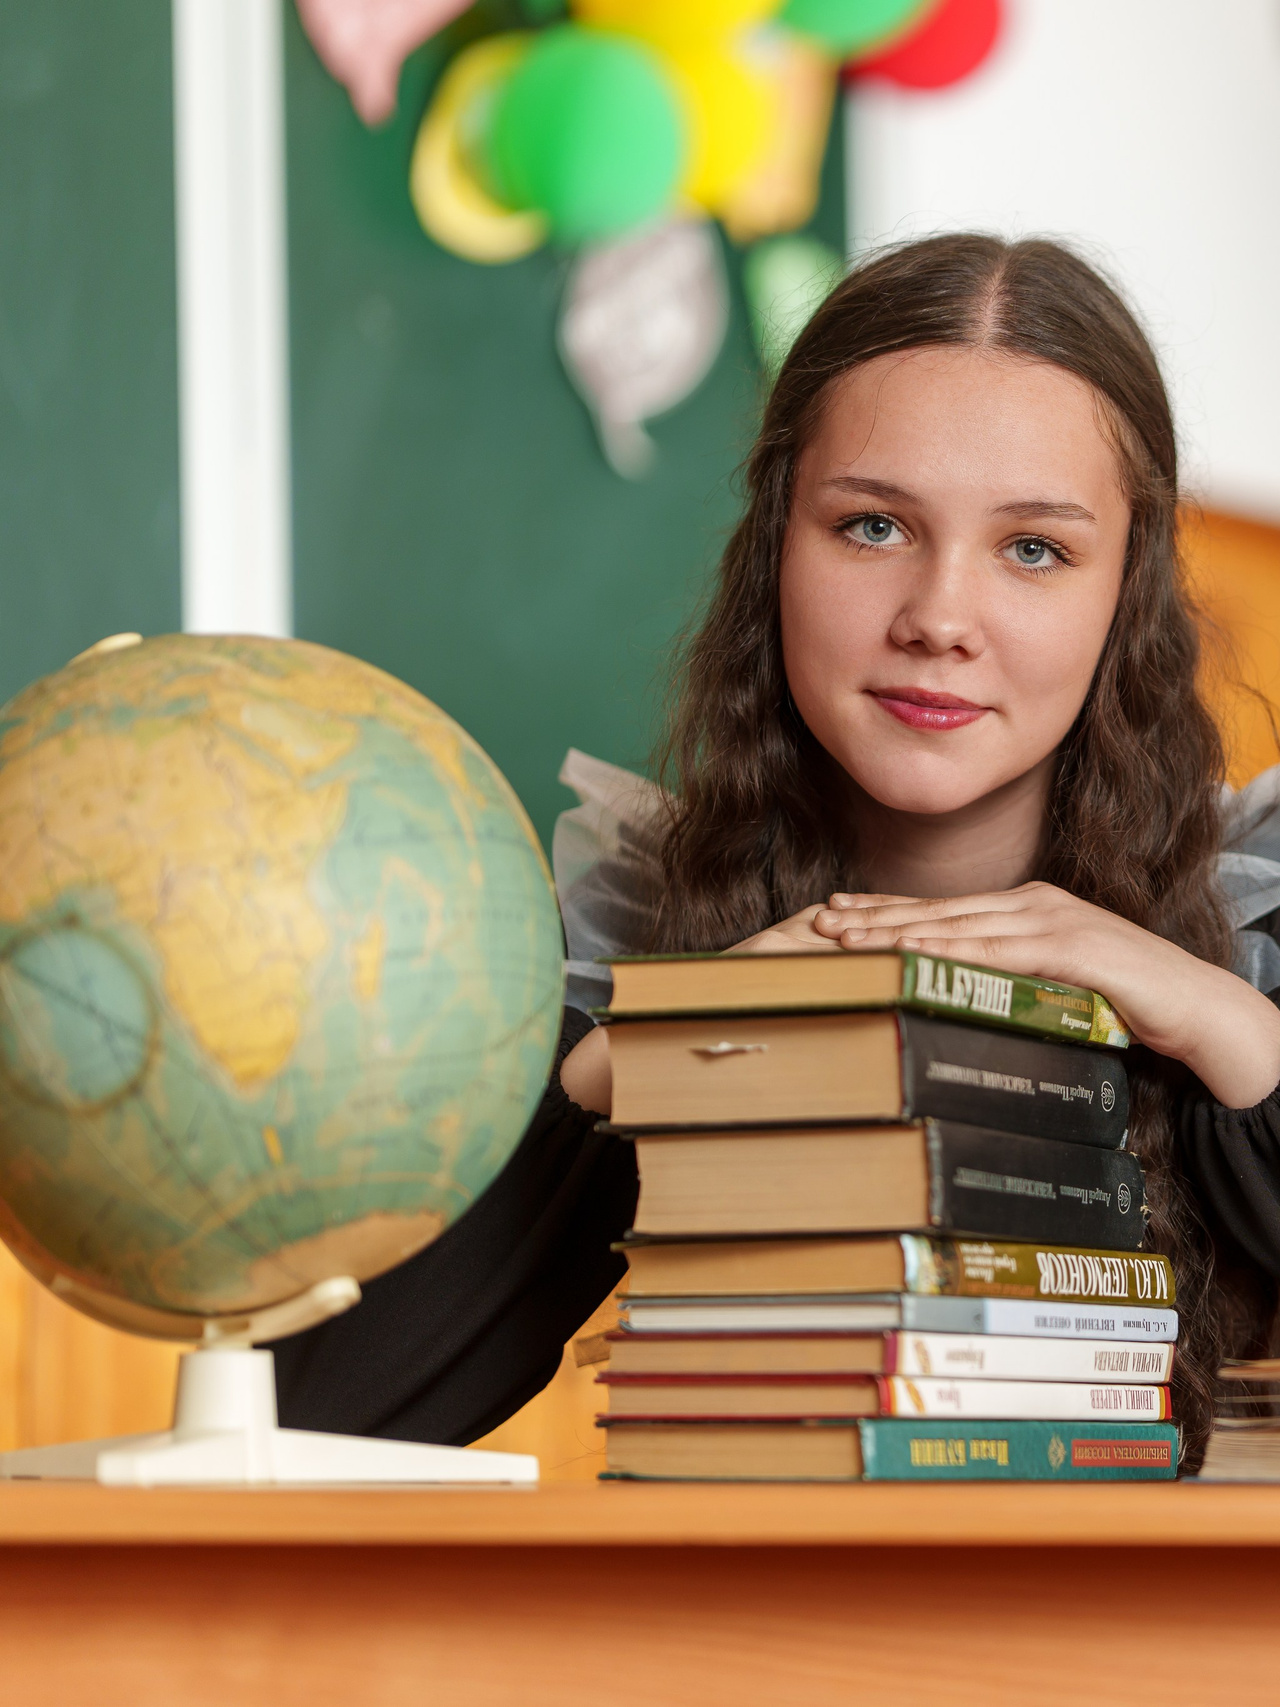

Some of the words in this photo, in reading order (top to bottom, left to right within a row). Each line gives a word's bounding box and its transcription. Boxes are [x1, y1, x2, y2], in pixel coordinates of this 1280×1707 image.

[1035, 1252, 1129, 1298] ЛЕРМОНТОВ
[1075, 1316, 1116, 1332] ЕВГЕНИЙ
[1123, 1318, 1152, 1332] Пушкин
[1094, 1349, 1130, 1372] ЦВЕТАЕВА
[1132, 1351, 1164, 1374] МАРИНА
[1089, 1386, 1122, 1410] АНДРЕЕВ
[1124, 1386, 1155, 1411] ЛЕОНИД
[969, 1439, 1009, 1466] Иван
[1073, 1445, 1111, 1460] ПОЭЗИИ
[1113, 1445, 1169, 1460] БИБЛИОТЕКА
